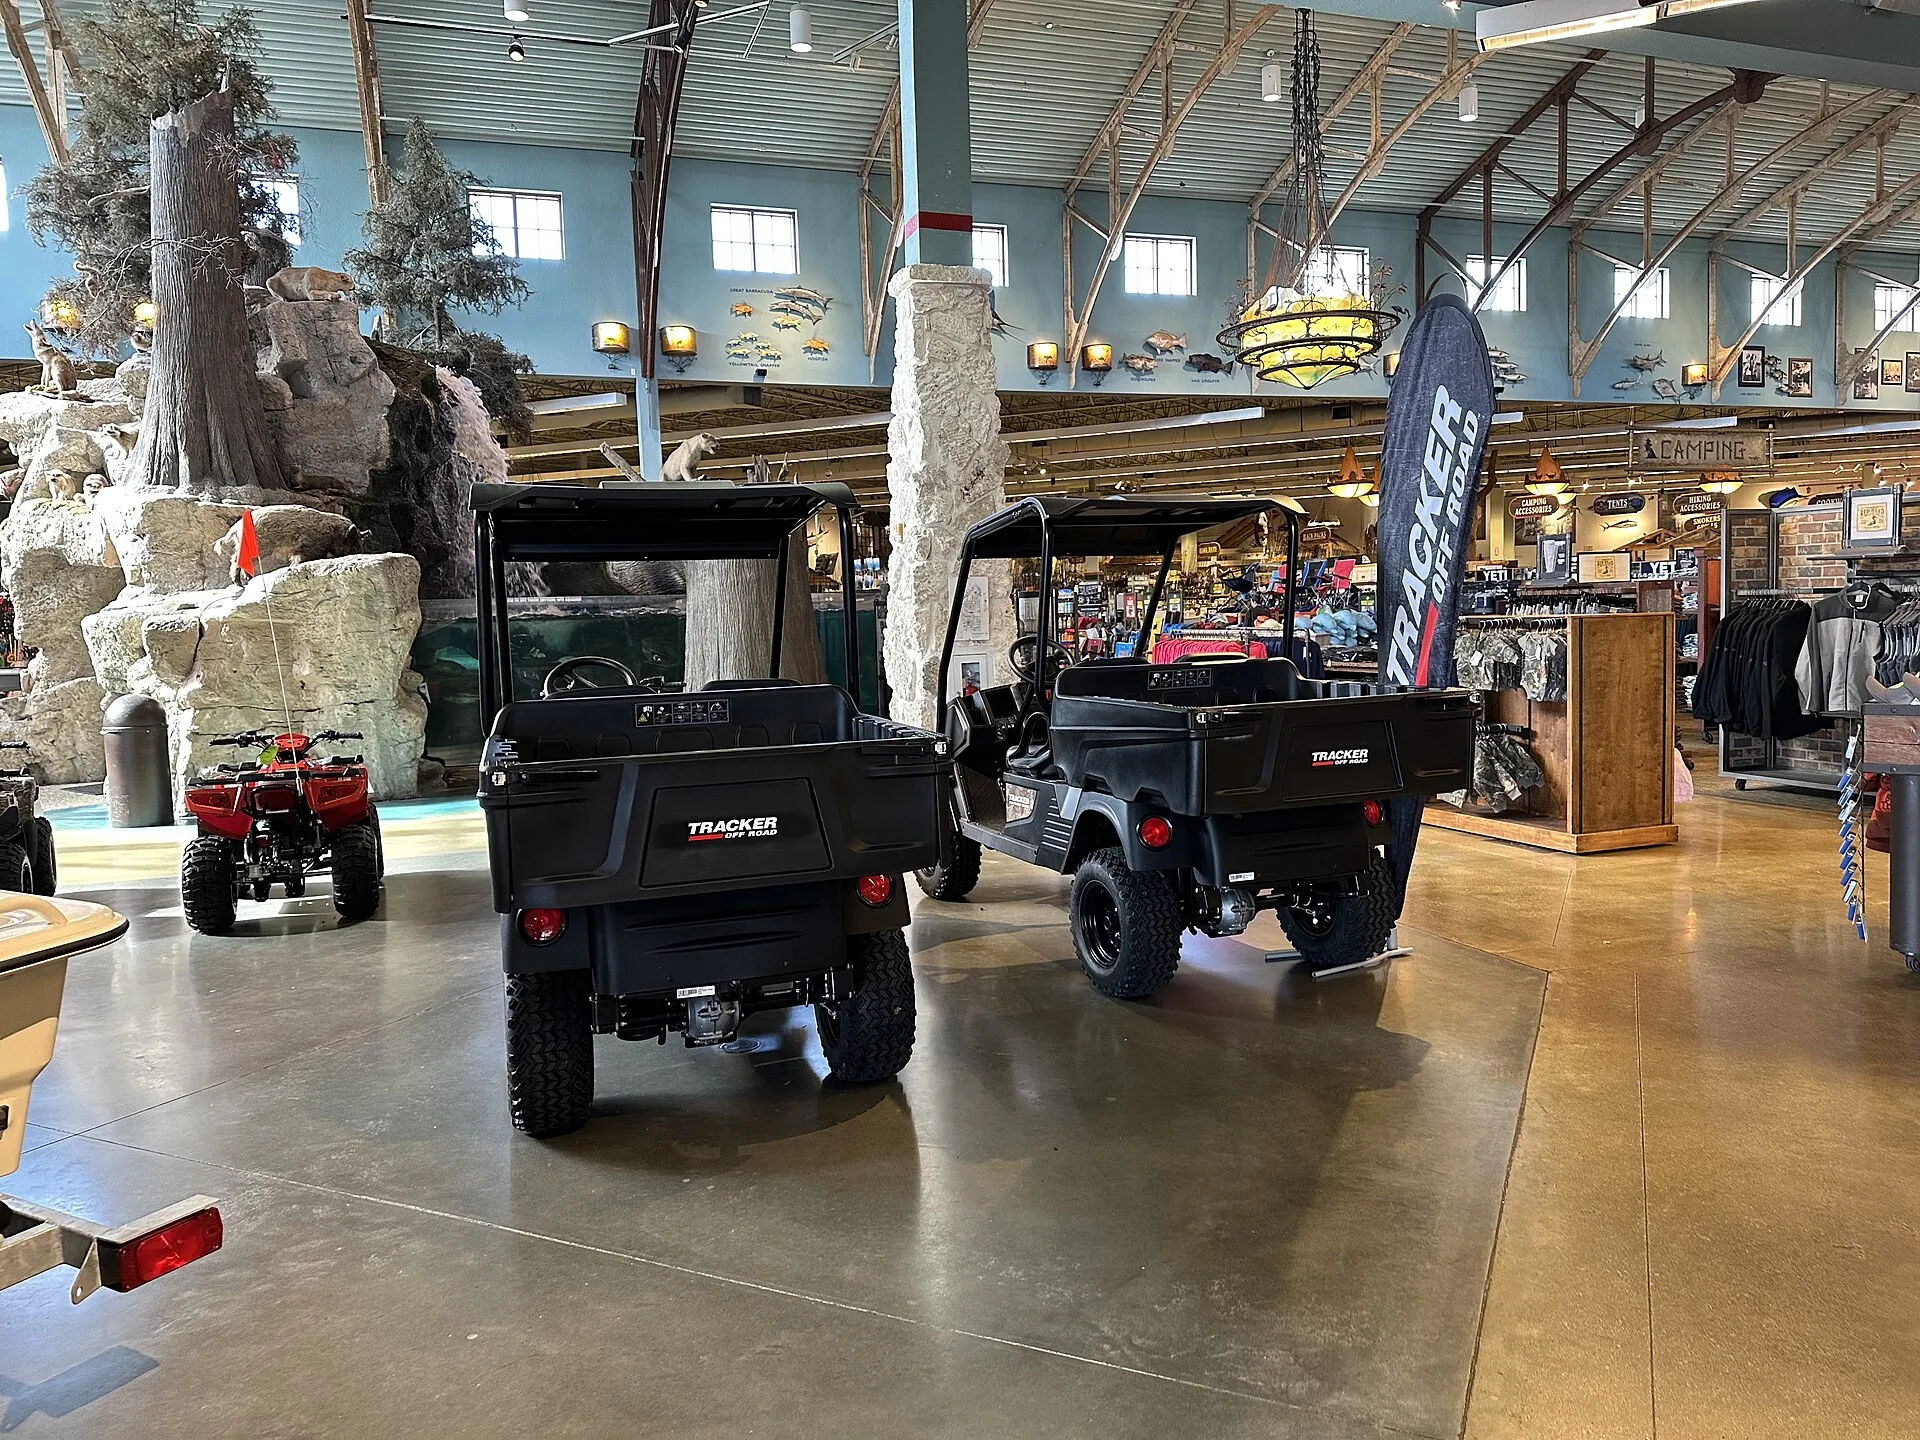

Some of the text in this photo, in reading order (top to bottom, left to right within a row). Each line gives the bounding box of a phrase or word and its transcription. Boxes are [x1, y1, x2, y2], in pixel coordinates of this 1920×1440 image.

[1660, 440, 1746, 461] CAMPING
[1521, 497, 1547, 507] CAMPING
[1607, 498, 1628, 509] TENTS
[1689, 495, 1712, 504] HIKING
[1431, 409, 1479, 604] OFF ROAD
[1514, 504, 1553, 516] ACCESSORIES
[1679, 501, 1721, 513] ACCESSORIES
[1386, 384, 1462, 686] TRACKER
[1483, 570, 1508, 581] YETI
[1311, 748, 1369, 762] TRACKER
[687, 816, 779, 835] TRACKER
[724, 828, 779, 839] OFF ROAD
